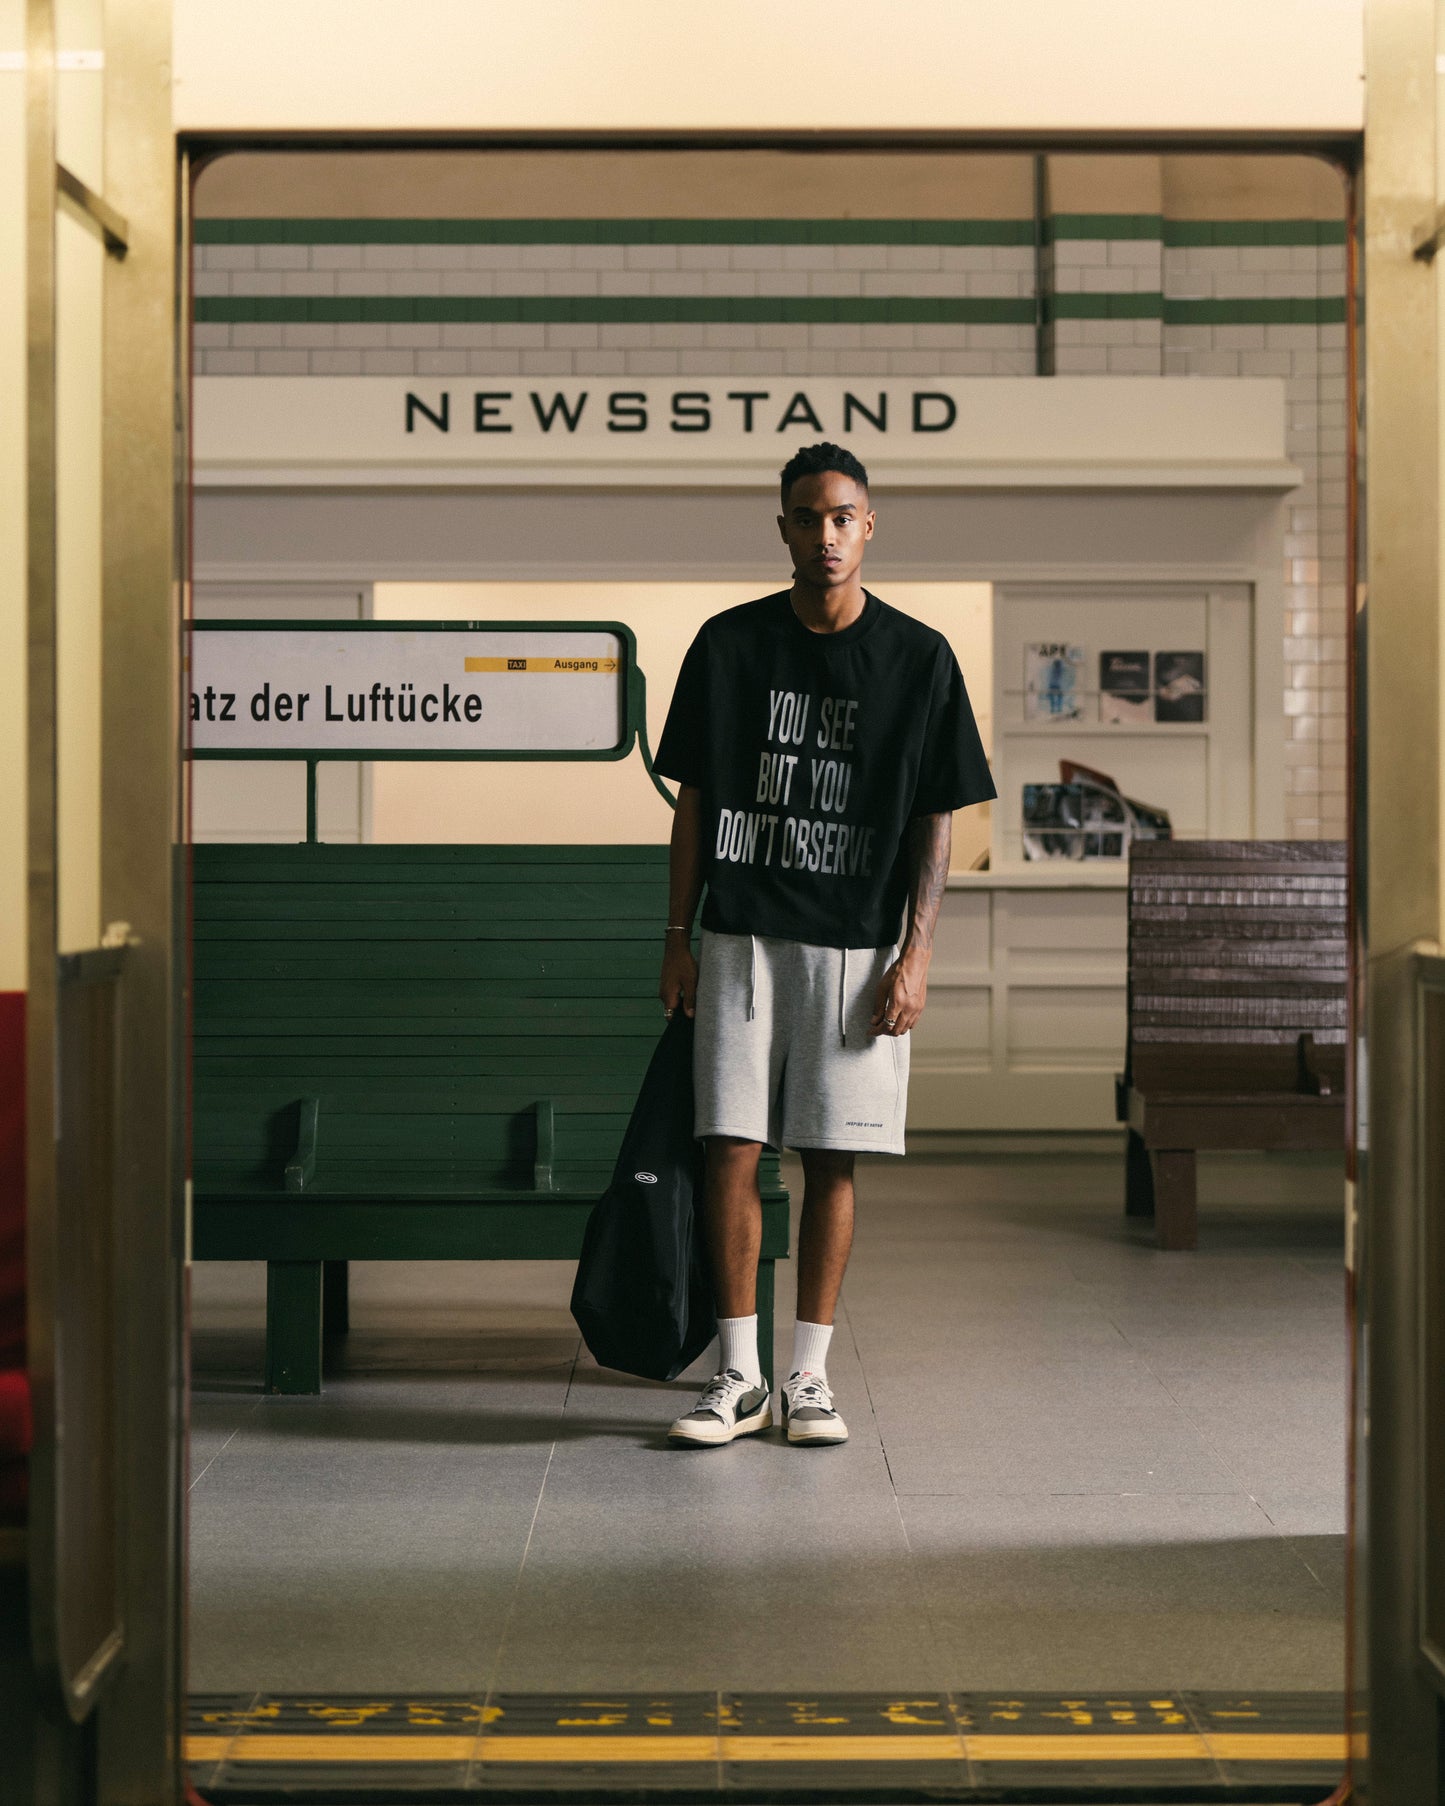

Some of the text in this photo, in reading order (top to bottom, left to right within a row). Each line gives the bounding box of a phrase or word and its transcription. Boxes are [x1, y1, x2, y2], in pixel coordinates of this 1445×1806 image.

[405, 392, 957, 433] NEWSSTAND
[508, 659, 598, 671] TAXI Ausgang
[250, 682, 310, 722] der
[325, 682, 483, 722] Luftücke
[768, 690, 858, 750] YOU SEE
[756, 752, 852, 813] BUT YOU
[715, 808, 876, 877] DON'T OBSERVE
